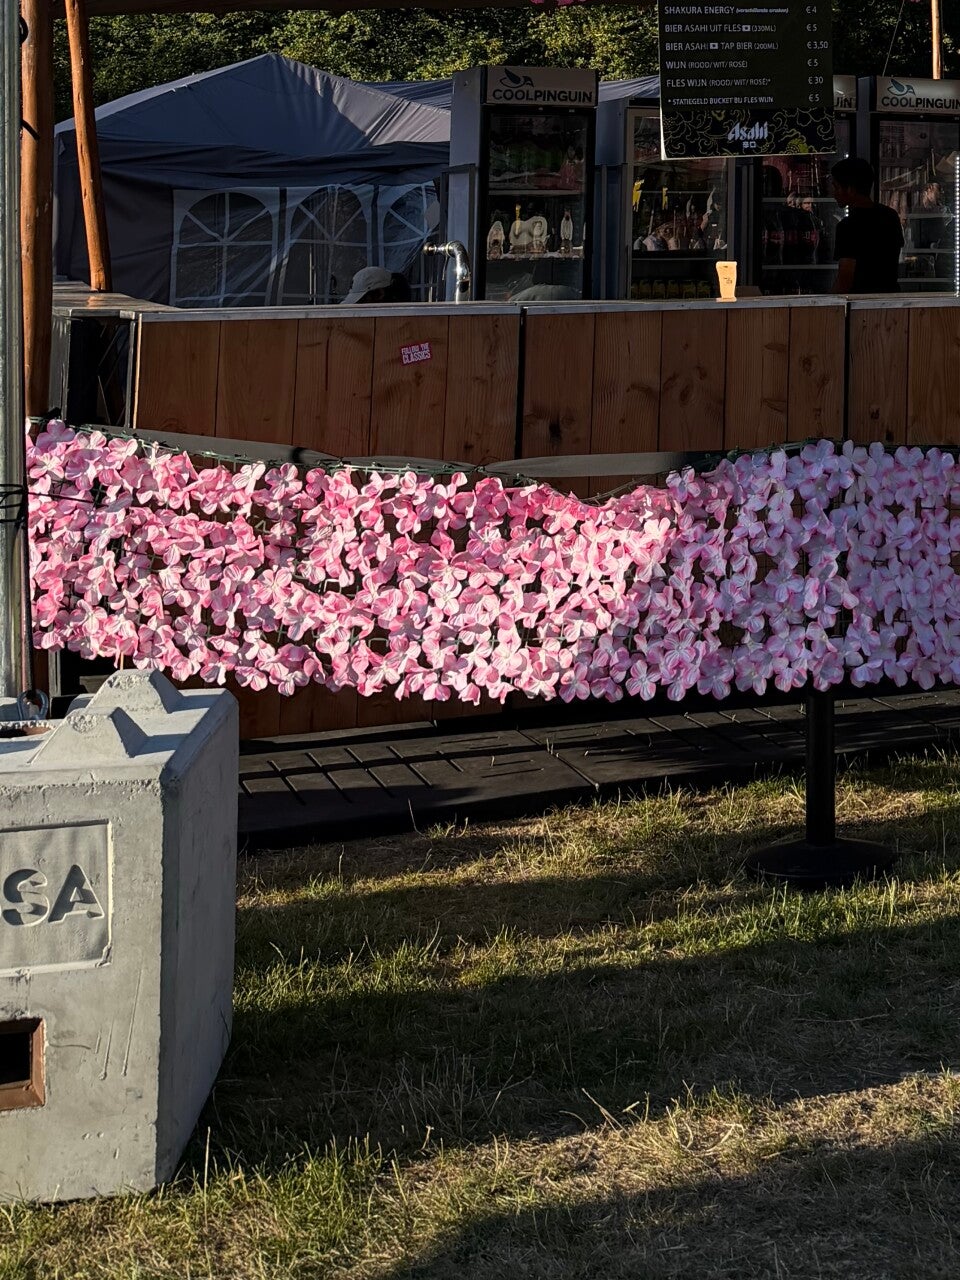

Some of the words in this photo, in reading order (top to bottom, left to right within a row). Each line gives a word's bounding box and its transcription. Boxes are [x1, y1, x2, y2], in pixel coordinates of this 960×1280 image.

[664, 6, 702, 15] SHAKURA
[704, 6, 735, 14] ENERGY
[805, 6, 810, 14] €
[811, 6, 816, 14] 4
[664, 24, 683, 32] BIER
[684, 24, 708, 32] ASAHI
[709, 24, 722, 32] UIT
[724, 24, 742, 32] FLES
[806, 24, 812, 32] €
[812, 24, 818, 32] 5
[665, 42, 684, 51] BIER
[684, 42, 709, 51] ASAHI
[720, 42, 735, 50] TAP
[736, 42, 753, 50] BIER
[806, 40, 812, 50] €
[812, 40, 829, 50] 3,50
[666, 61, 687, 70] WIJN
[807, 58, 812, 67] €
[814, 58, 819, 67] 5
[666, 79, 686, 88] FLES
[686, 79, 707, 88] WIJN
[808, 76, 814, 85] €
[814, 76, 824, 85] 30
[492, 89, 592, 102] COOLPINGUIN
[808, 94, 814, 102] €
[814, 94, 820, 102] 5
[672, 98, 709, 106] STATIEGELD
[743, 96, 758, 104] FLES
[758, 96, 774, 104] WIJN
[727, 121, 768, 141] Asahi
[0, 864, 104, 927] SA
